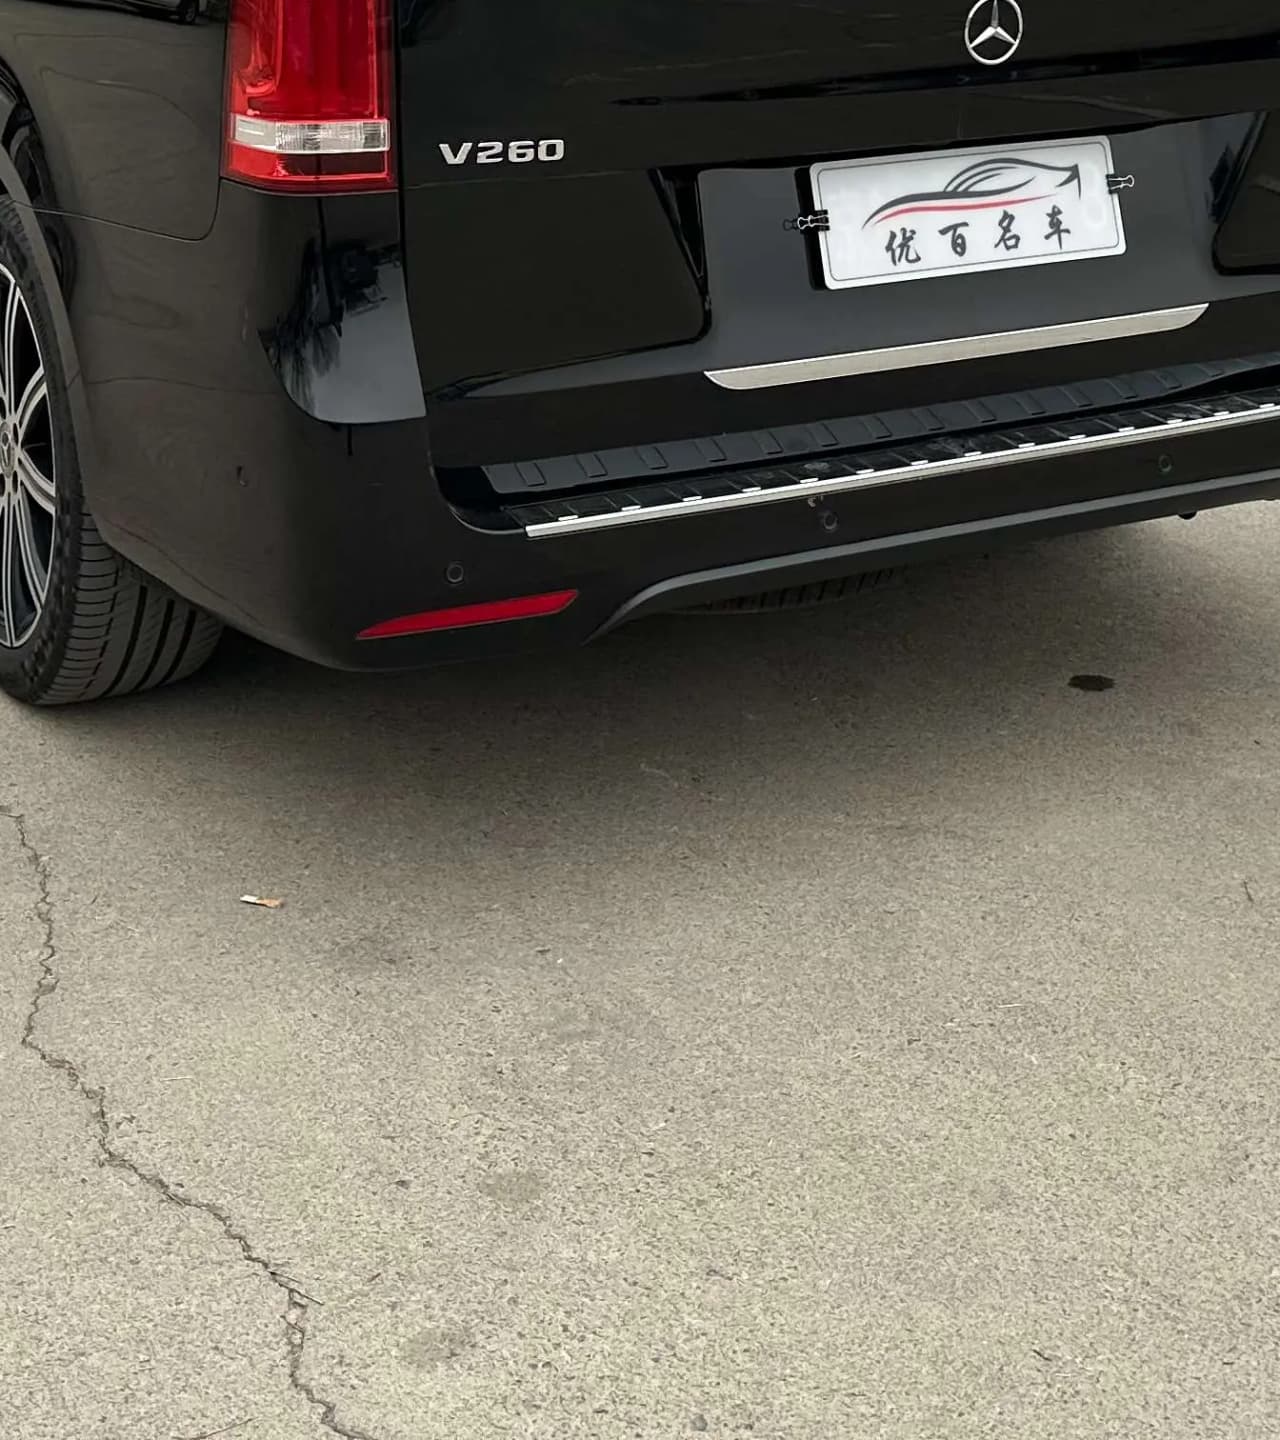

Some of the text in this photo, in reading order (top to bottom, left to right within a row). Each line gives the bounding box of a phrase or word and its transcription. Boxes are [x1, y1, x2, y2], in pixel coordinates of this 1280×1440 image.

[438, 139, 565, 165] V260
[884, 204, 1072, 267] 优百名车
